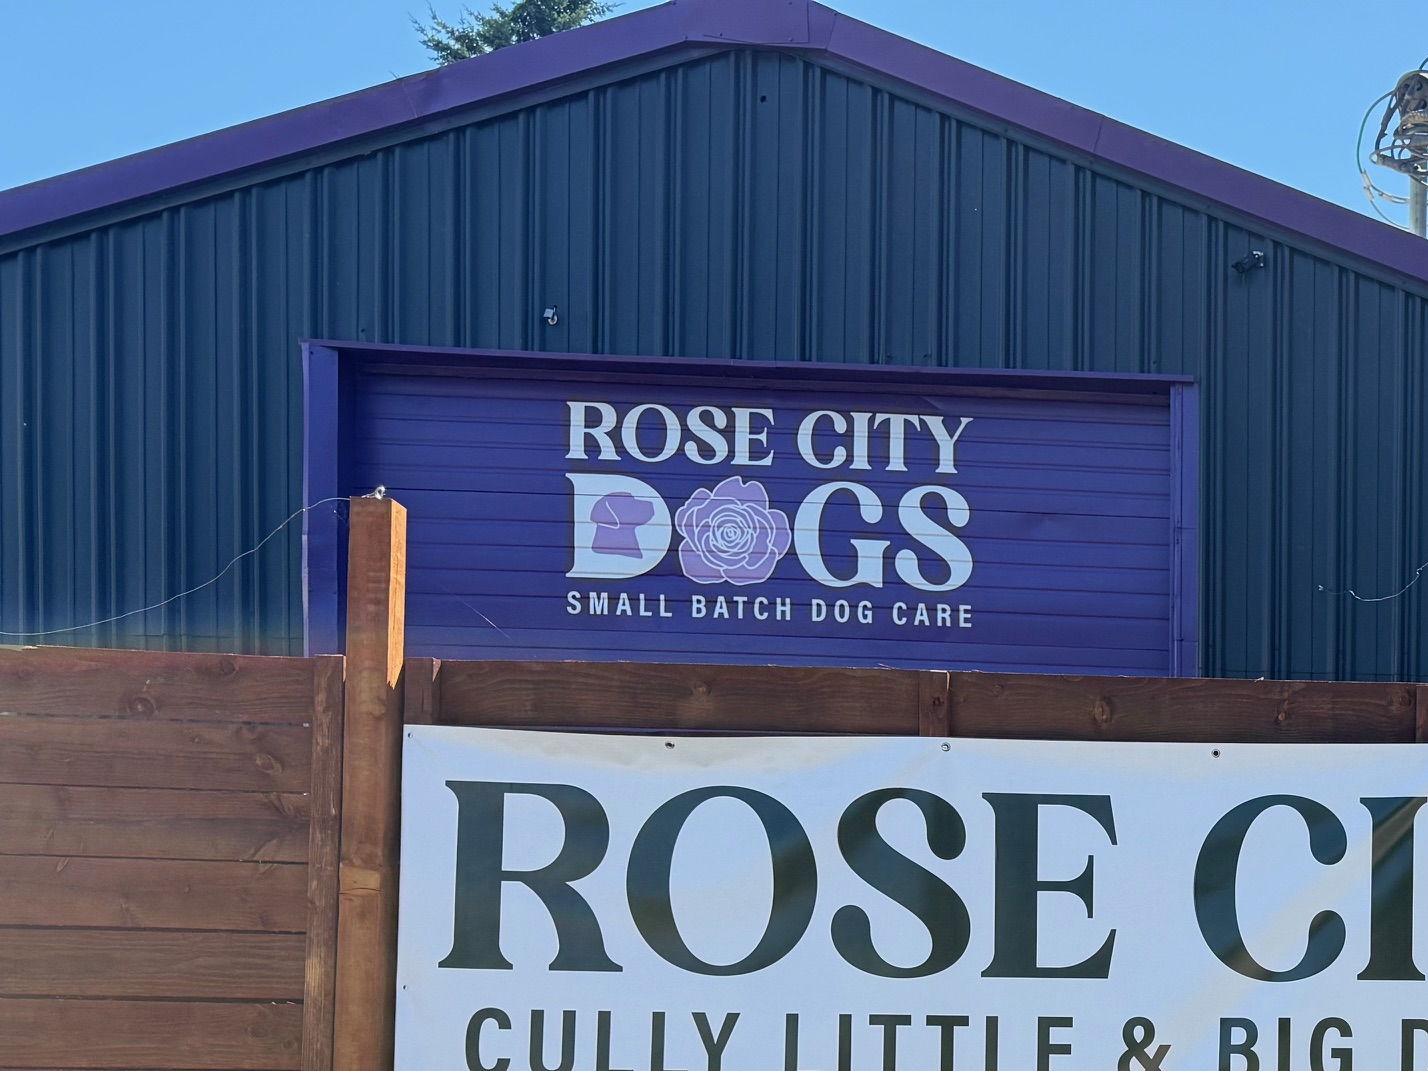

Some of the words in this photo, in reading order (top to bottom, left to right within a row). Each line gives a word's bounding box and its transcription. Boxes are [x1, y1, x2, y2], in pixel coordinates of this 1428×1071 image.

[566, 402, 774, 465] ROSE
[798, 411, 973, 473] CITY
[567, 591, 672, 616] SMALL
[693, 596, 790, 620] BATCH
[812, 599, 872, 623] DOG
[893, 602, 971, 627] CARE
[438, 781, 1117, 978] ROSE
